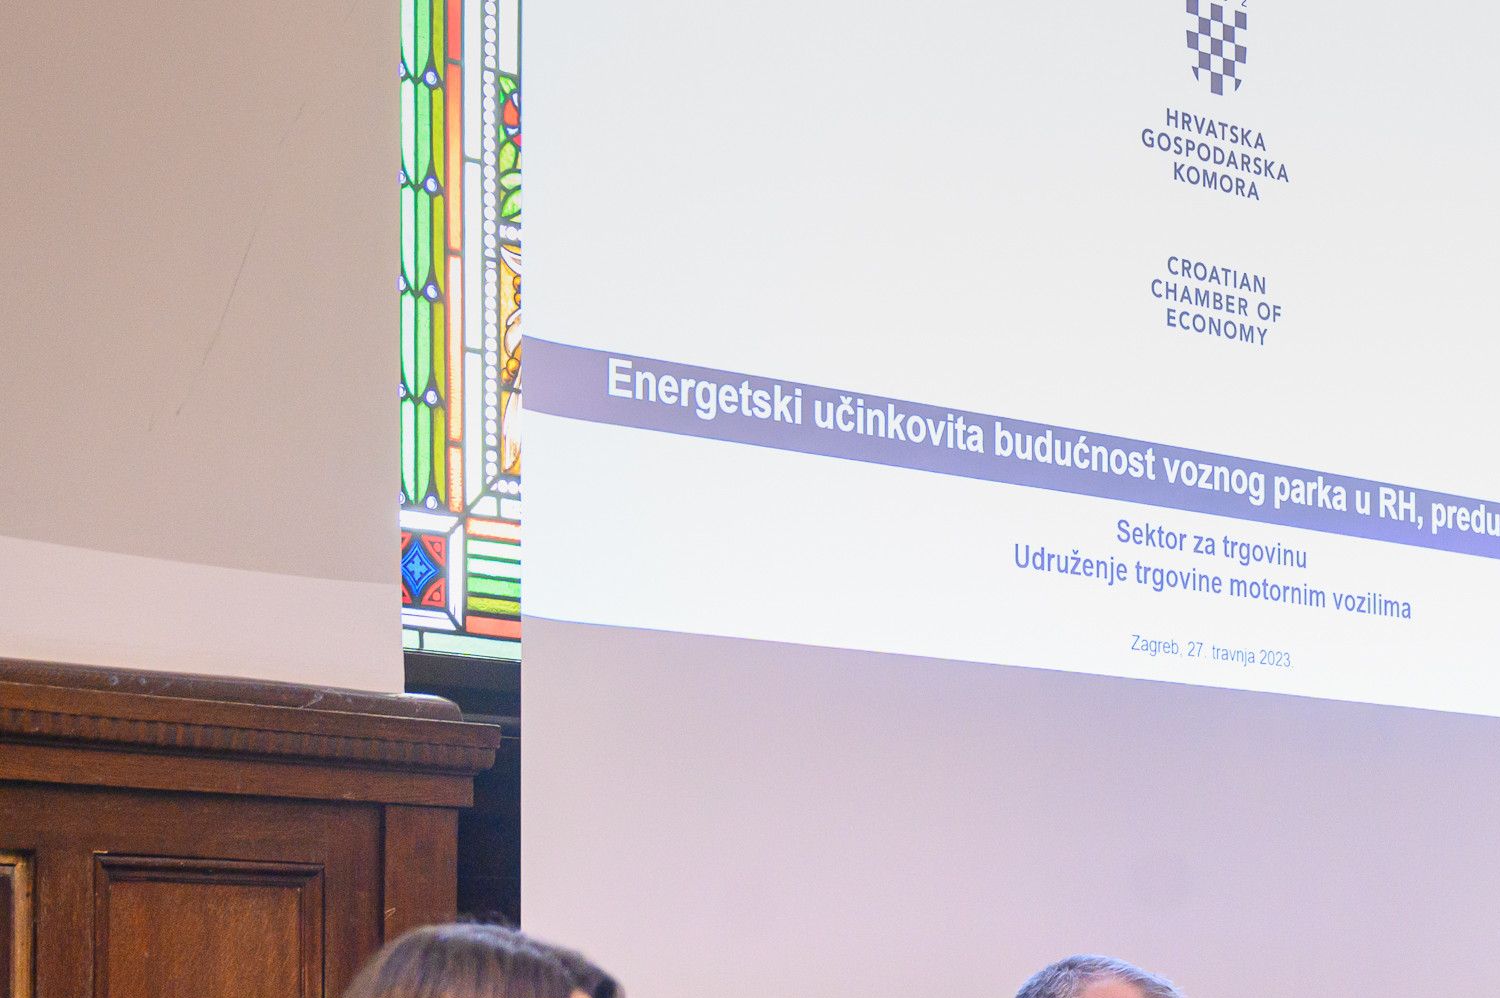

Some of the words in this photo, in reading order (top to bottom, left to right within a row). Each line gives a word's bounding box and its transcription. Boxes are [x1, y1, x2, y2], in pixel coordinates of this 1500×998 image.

[1166, 107, 1266, 151] HRVATSKA
[1141, 128, 1289, 183] GOSPODARSKA
[1173, 161, 1260, 201] KOMORA
[1167, 256, 1266, 295] CROATIAN
[1151, 279, 1248, 317] CHAMBER
[1257, 302, 1281, 323] OF
[1166, 308, 1268, 346] ECONOMY
[607, 357, 802, 424] Energetski
[813, 396, 984, 454] učinkovita
[994, 421, 1156, 481] budućnost
[1163, 455, 1265, 506] voznog
[1274, 475, 1347, 512] parka
[1355, 489, 1371, 515] u
[1379, 487, 1424, 530] RH,
[1117, 519, 1187, 552] Sektor
[1193, 533, 1216, 556] za
[1223, 535, 1308, 569] trgovinu
[1014, 543, 1128, 586] Udruženje
[1135, 560, 1222, 593] trgovine
[1229, 577, 1326, 609] motornim
[1333, 591, 1412, 619] vozilima
[1131, 634, 1184, 658] Zagreb,
[1187, 640, 1208, 659] 27.
[1211, 643, 1256, 667] travnja
[1260, 648, 1294, 669] 2023.
